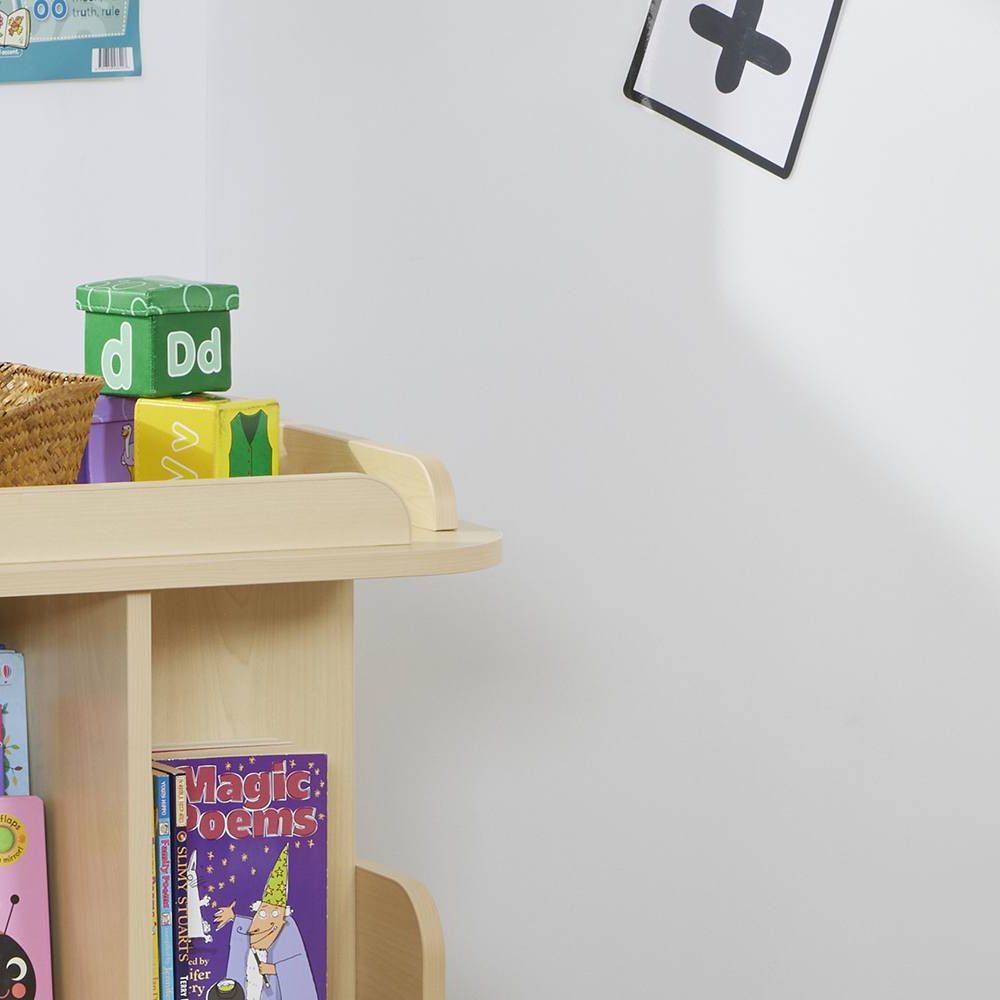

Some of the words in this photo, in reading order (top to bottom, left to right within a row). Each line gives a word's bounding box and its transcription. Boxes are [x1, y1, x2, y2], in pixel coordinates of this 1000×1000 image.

[72, 7, 99, 18] truth,
[101, 7, 120, 16] rule
[101, 321, 132, 391] d
[167, 326, 222, 378] Dd
[177, 760, 311, 811] Magic
[1, 814, 21, 830] flaps
[160, 839, 170, 874] Family
[177, 846, 188, 891] SLIMY
[162, 875, 171, 908] Poems
[178, 896, 189, 962] STUARTS
[200, 957, 209, 966] by
[180, 975, 188, 997] TERRY
